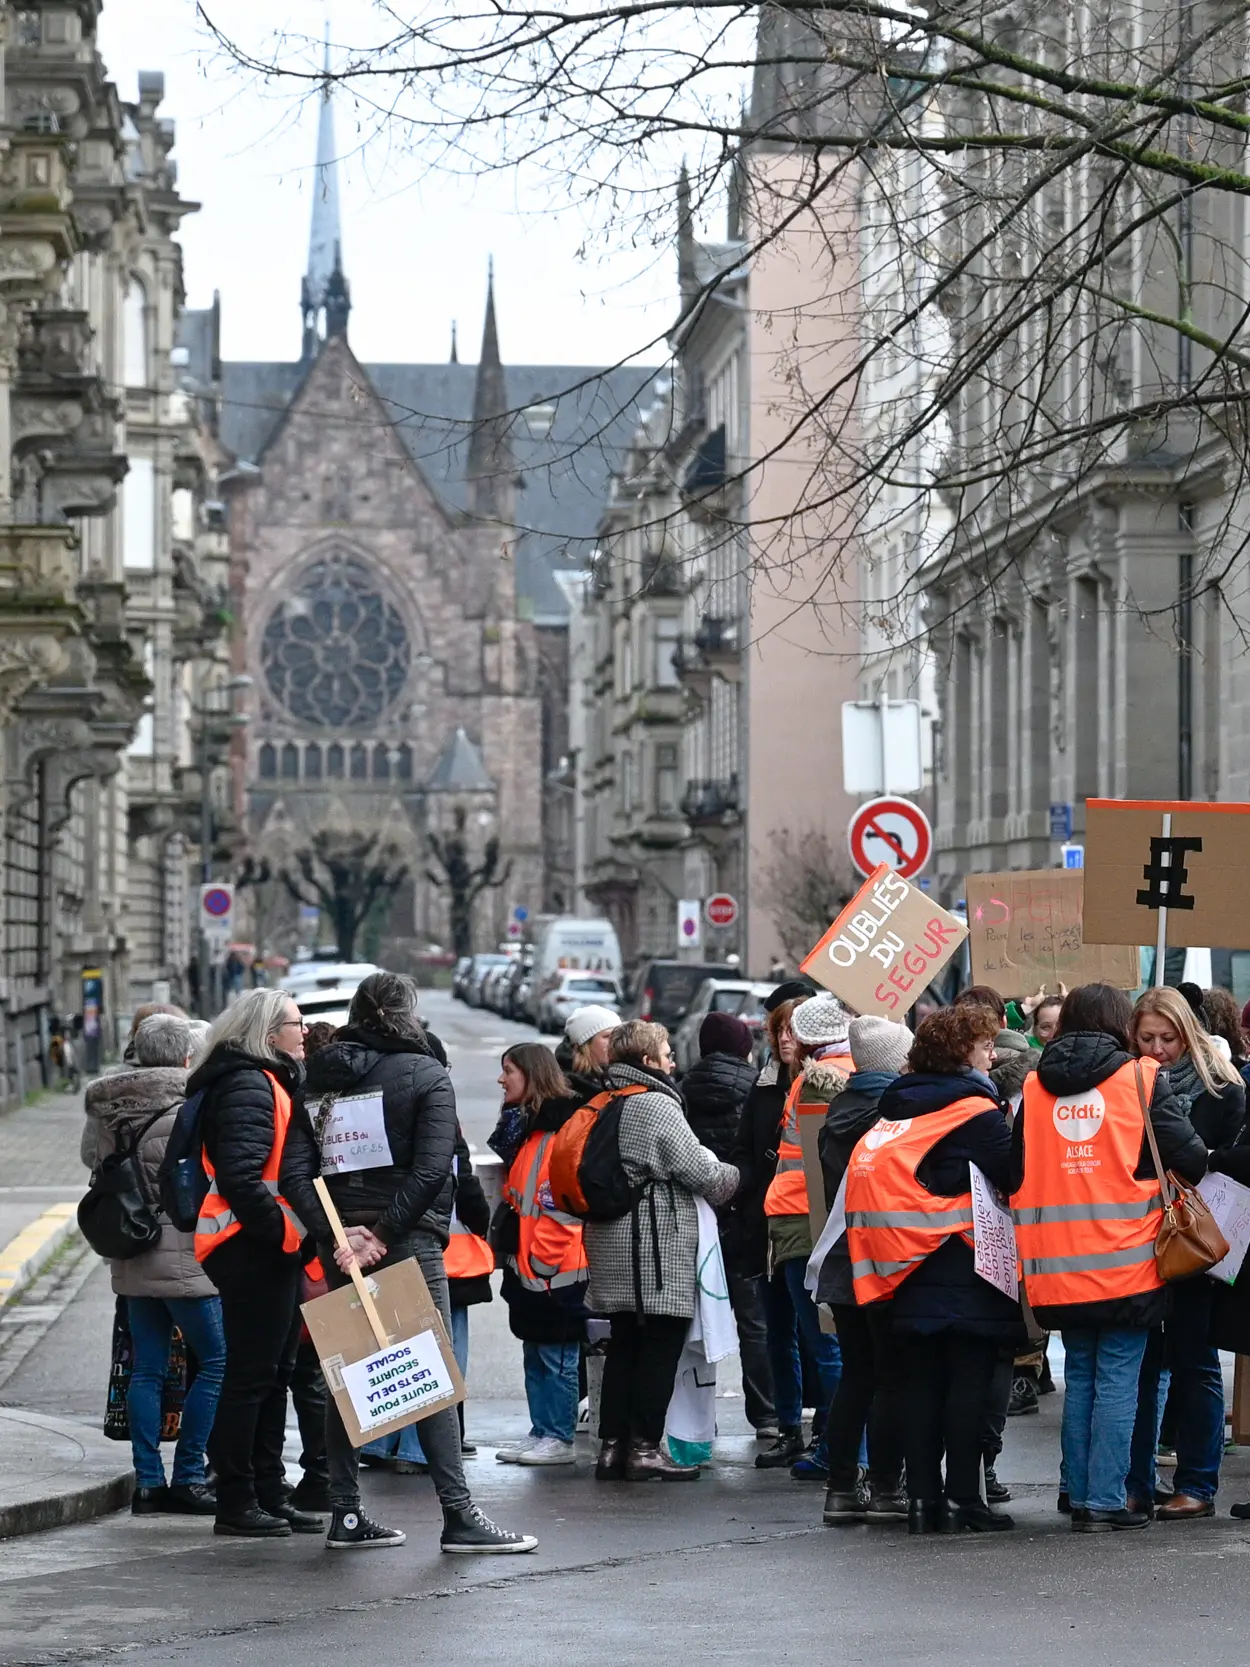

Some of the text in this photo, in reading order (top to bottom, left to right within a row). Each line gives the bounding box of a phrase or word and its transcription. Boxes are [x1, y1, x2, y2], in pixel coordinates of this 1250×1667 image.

[828, 873, 910, 967] OUBLIÉS
[987, 889, 1081, 925] SEGU
[869, 931, 905, 969] DU
[875, 918, 958, 1010] SEGUR
[1057, 1104, 1101, 1120] Cfdt:
[1066, 1145, 1094, 1159] ALSACE
[976, 1240, 984, 1273] Les
[366, 1347, 411, 1373] SOCIALE
[368, 1359, 419, 1387] SECURITE
[366, 1368, 431, 1403] LES TS DE LA
[370, 1380, 439, 1417] EQUITE POUR
